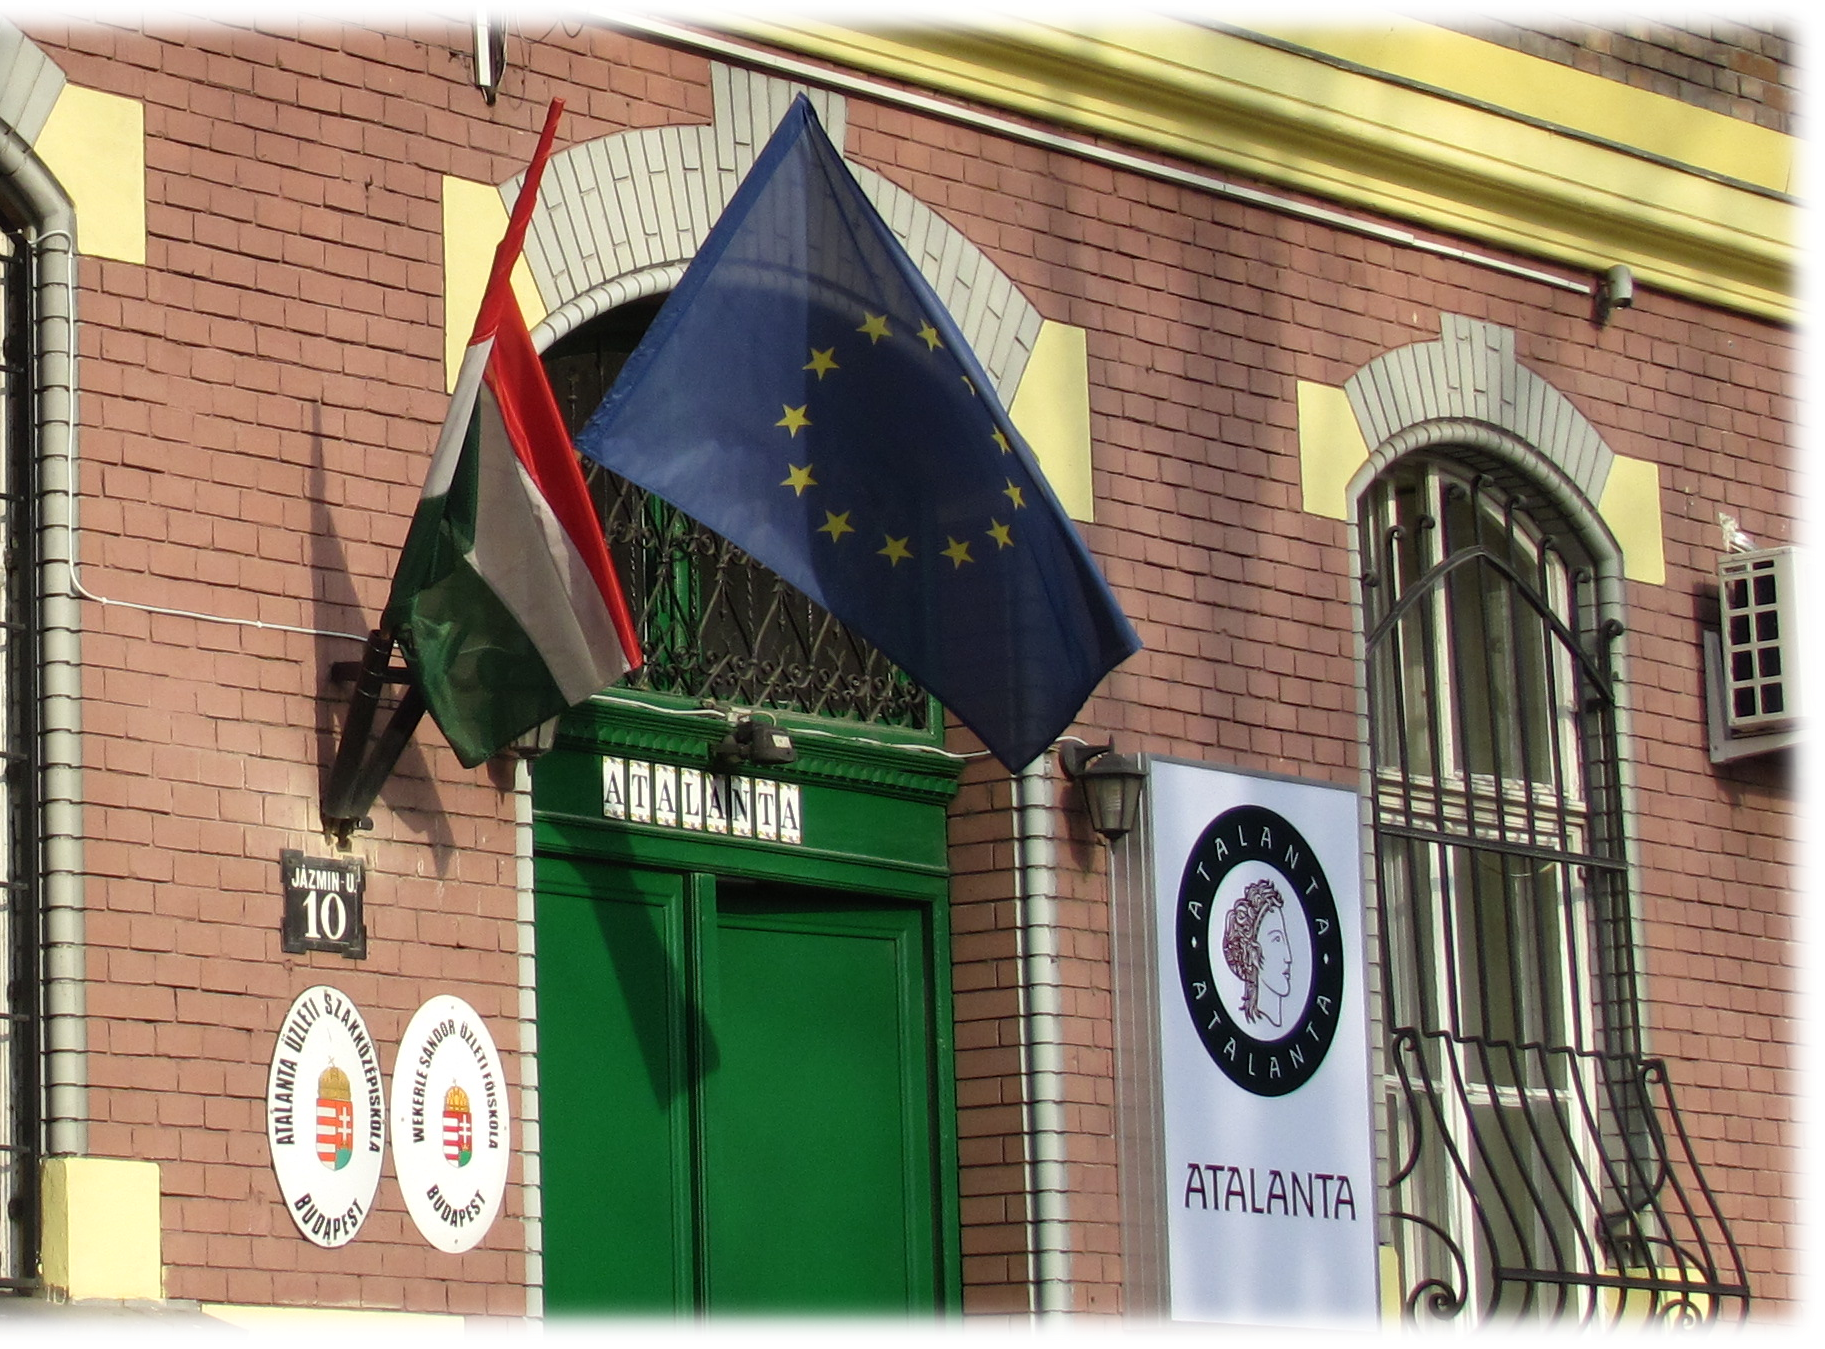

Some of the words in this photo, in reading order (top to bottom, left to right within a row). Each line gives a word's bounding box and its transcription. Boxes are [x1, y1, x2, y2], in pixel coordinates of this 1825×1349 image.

[605, 770, 798, 830] ATALANTA
[1188, 824, 1330, 936] ATALANTA
[302, 890, 347, 940] 10
[281, 997, 320, 1053] ÜZLETI
[1192, 980, 1332, 1079] ATALANTA
[274, 1058, 297, 1145] ATALANTA
[324, 991, 382, 1153] SZAKKÖZÉPISKOLA
[412, 1069, 428, 1143] WEKERLE
[460, 1021, 488, 1070] ÜZLETI
[294, 1193, 363, 1241] BUDAPEST
[426, 1183, 486, 1228] BUDAPEST
[1184, 1162, 1356, 1221] ATALANTA
